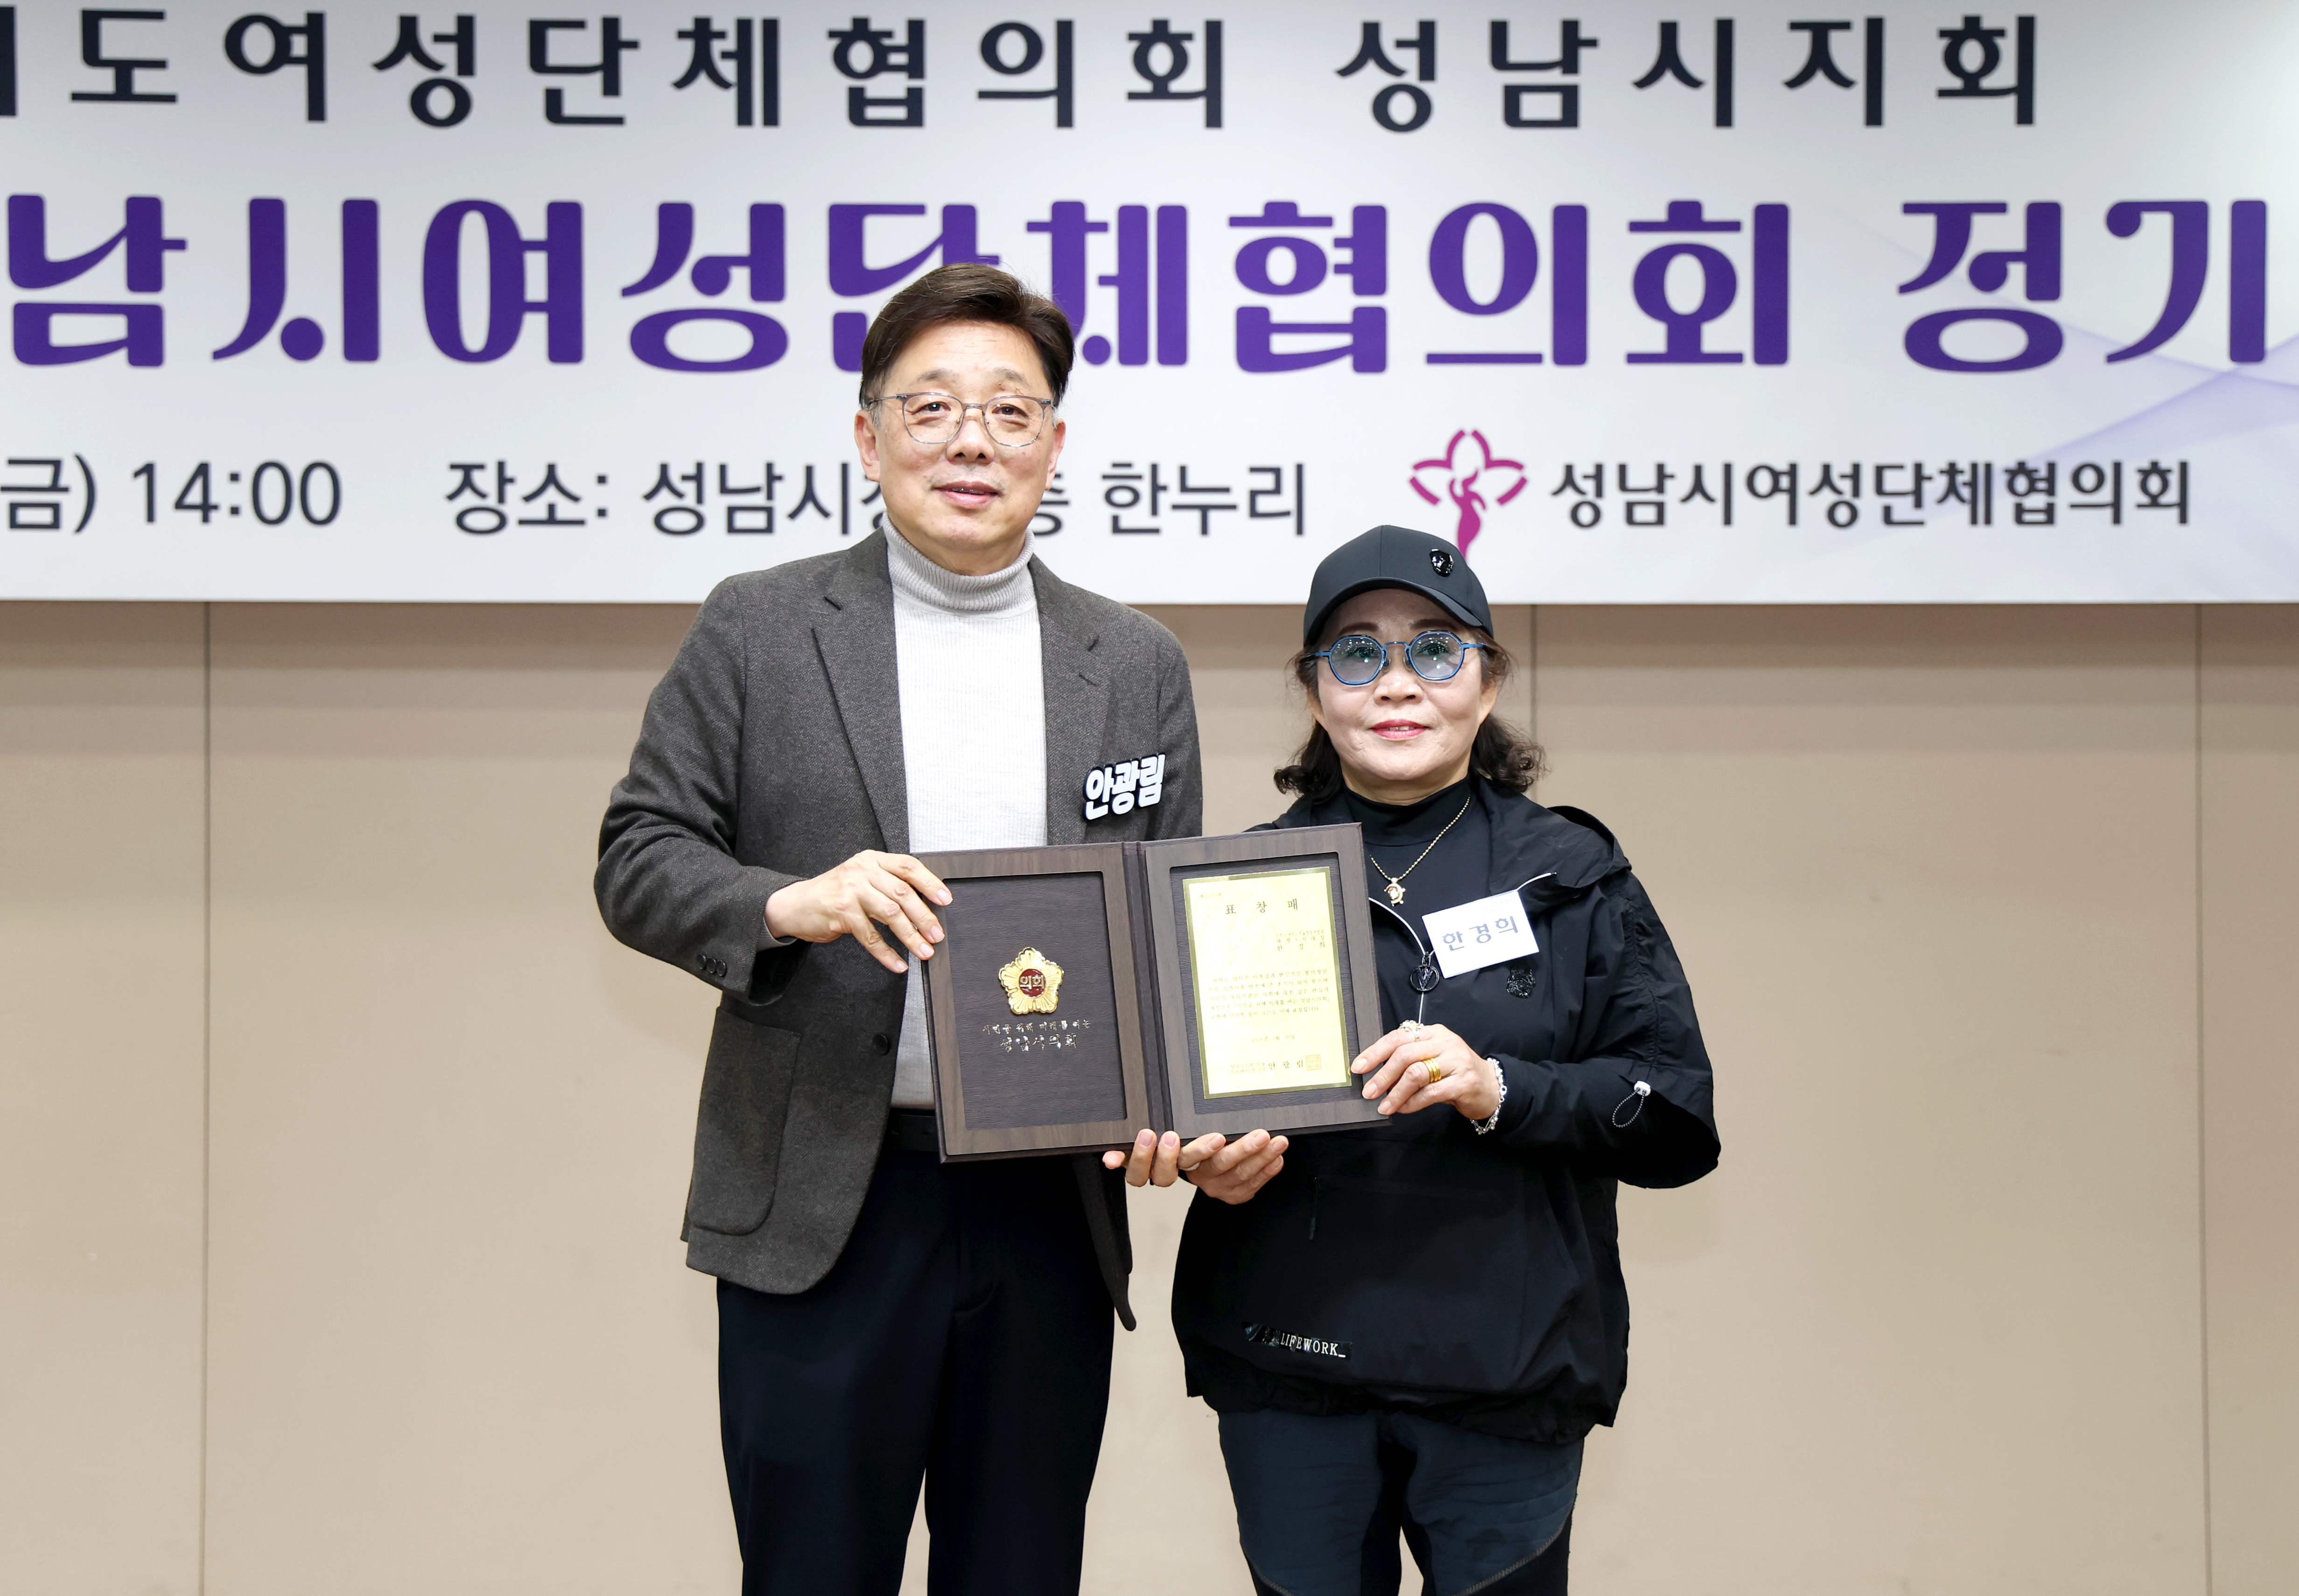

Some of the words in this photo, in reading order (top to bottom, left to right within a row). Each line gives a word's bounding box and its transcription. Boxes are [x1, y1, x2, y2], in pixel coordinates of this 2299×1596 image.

[1336, 15, 2036, 133] 성남시지회
[1898, 200, 2266, 373] 정기
[132, 460, 343, 526] 14:00
[445, 461, 609, 535] 장소:
[1100, 462, 1306, 536] 한누리
[1551, 460, 2190, 529] 성남시여성단체협의회
[1085, 753, 1165, 820] 안광림
[1442, 916, 1518, 951] 한경희
[1020, 975, 1045, 989] 의회
